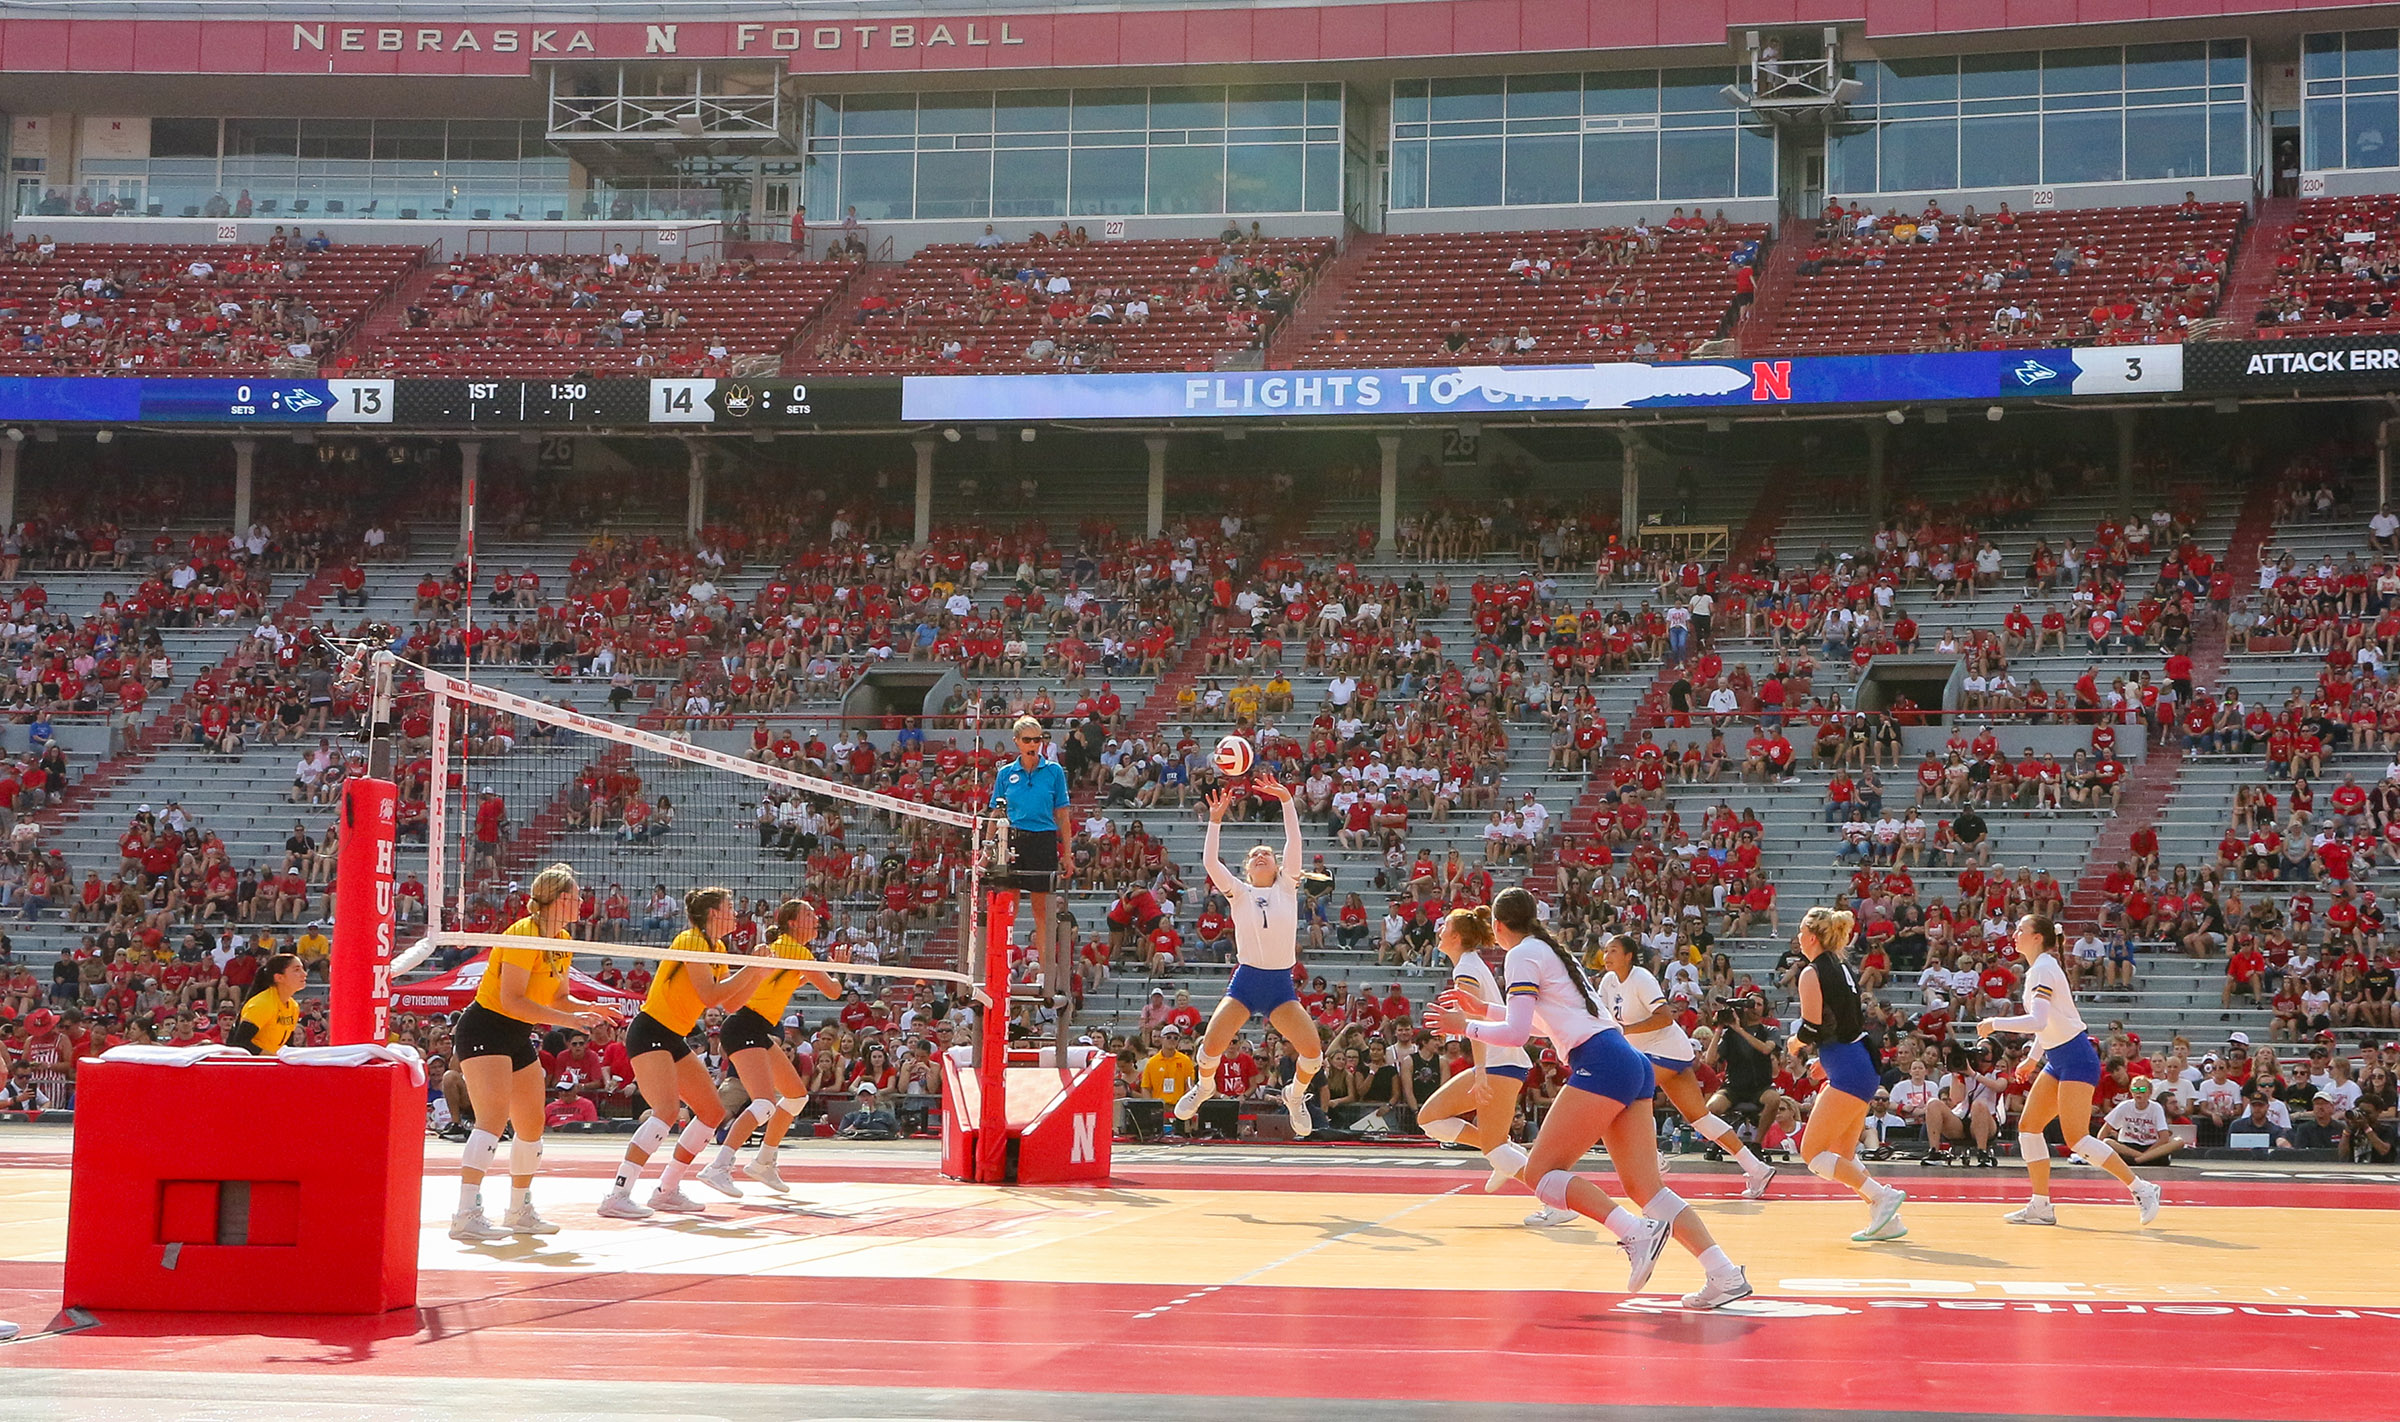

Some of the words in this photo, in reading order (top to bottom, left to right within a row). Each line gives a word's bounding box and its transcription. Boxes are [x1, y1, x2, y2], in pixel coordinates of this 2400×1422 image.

[293, 24, 596, 53] NEBRASKA
[646, 25, 677, 53] N
[737, 23, 1024, 50] FOOTBALL
[2034, 191, 2053, 204] 229
[218, 226, 236, 238] 225
[659, 230, 677, 241] 226
[1106, 222, 1123, 234] 227
[2125, 358, 2142, 381] 3
[2246, 351, 2345, 374] ATTACK
[2350, 349, 2400, 370] ERR
[1752, 361, 1791, 400] N
[237, 386, 251, 402] 0
[468, 383, 499, 399] 1ST
[550, 384, 588, 400] 1:30
[793, 385, 807, 401] 0
[1186, 376, 1382, 408] FLIGHTS
[1401, 374, 1460, 404] TO
[352, 388, 382, 414] 13
[662, 387, 693, 413] 14
[231, 405, 256, 415] SETS
[786, 404, 811, 414] SETS
[1443, 431, 1475, 456] 28
[1262, 910, 1268, 928] 1
[1071, 1113, 1096, 1163] N
